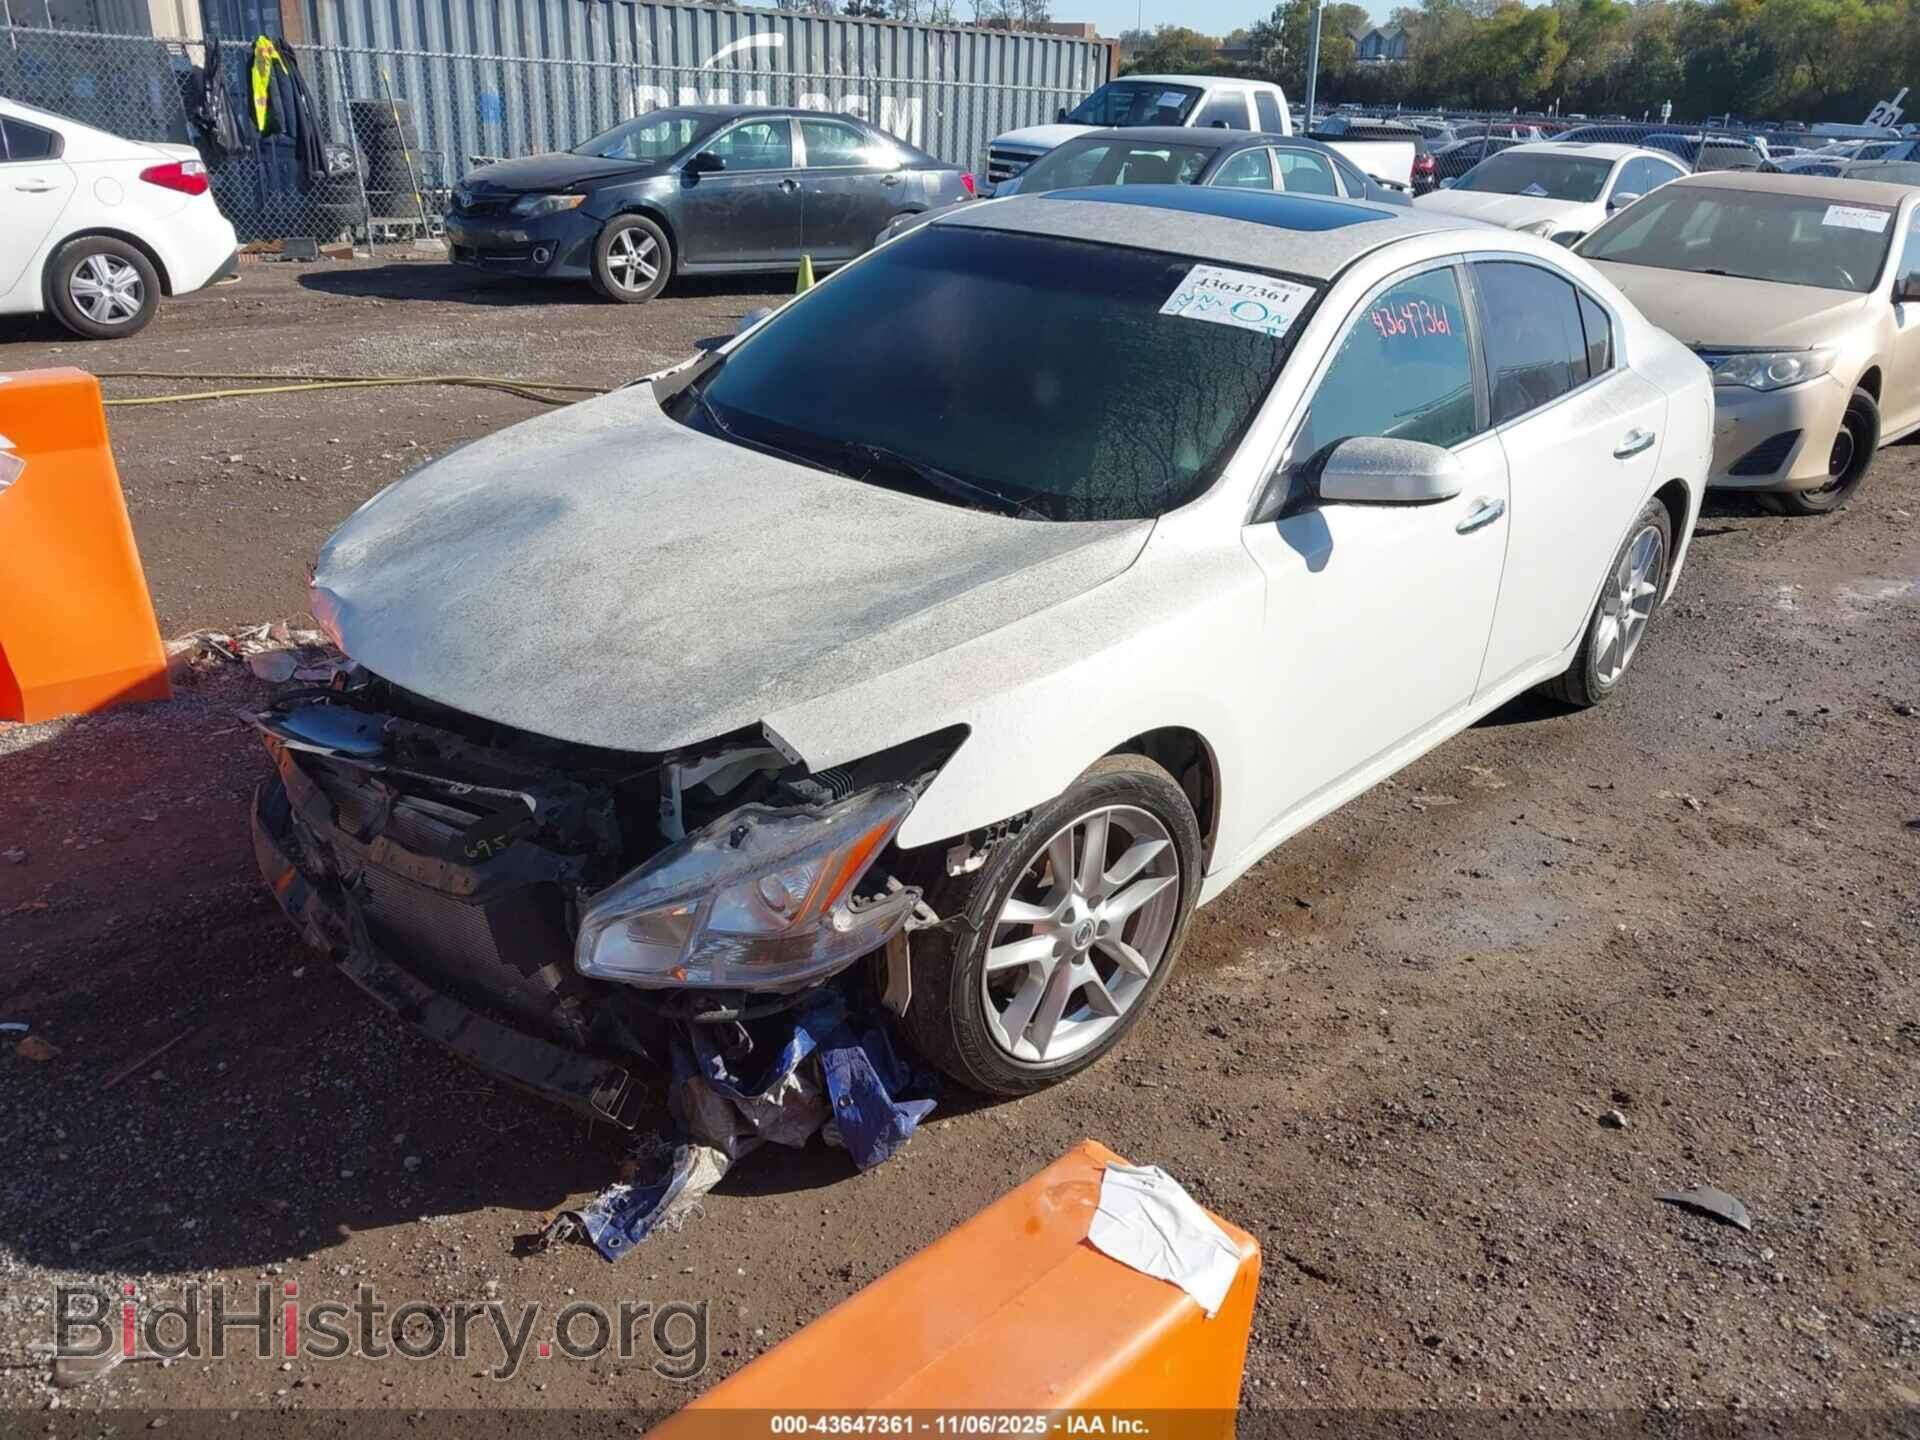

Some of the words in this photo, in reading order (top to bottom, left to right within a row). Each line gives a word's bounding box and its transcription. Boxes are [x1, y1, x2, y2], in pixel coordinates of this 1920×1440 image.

[1870, 107, 1896, 128] 20
[1196, 277, 1291, 303] 43647361
[1372, 299, 1452, 338] 43647361
